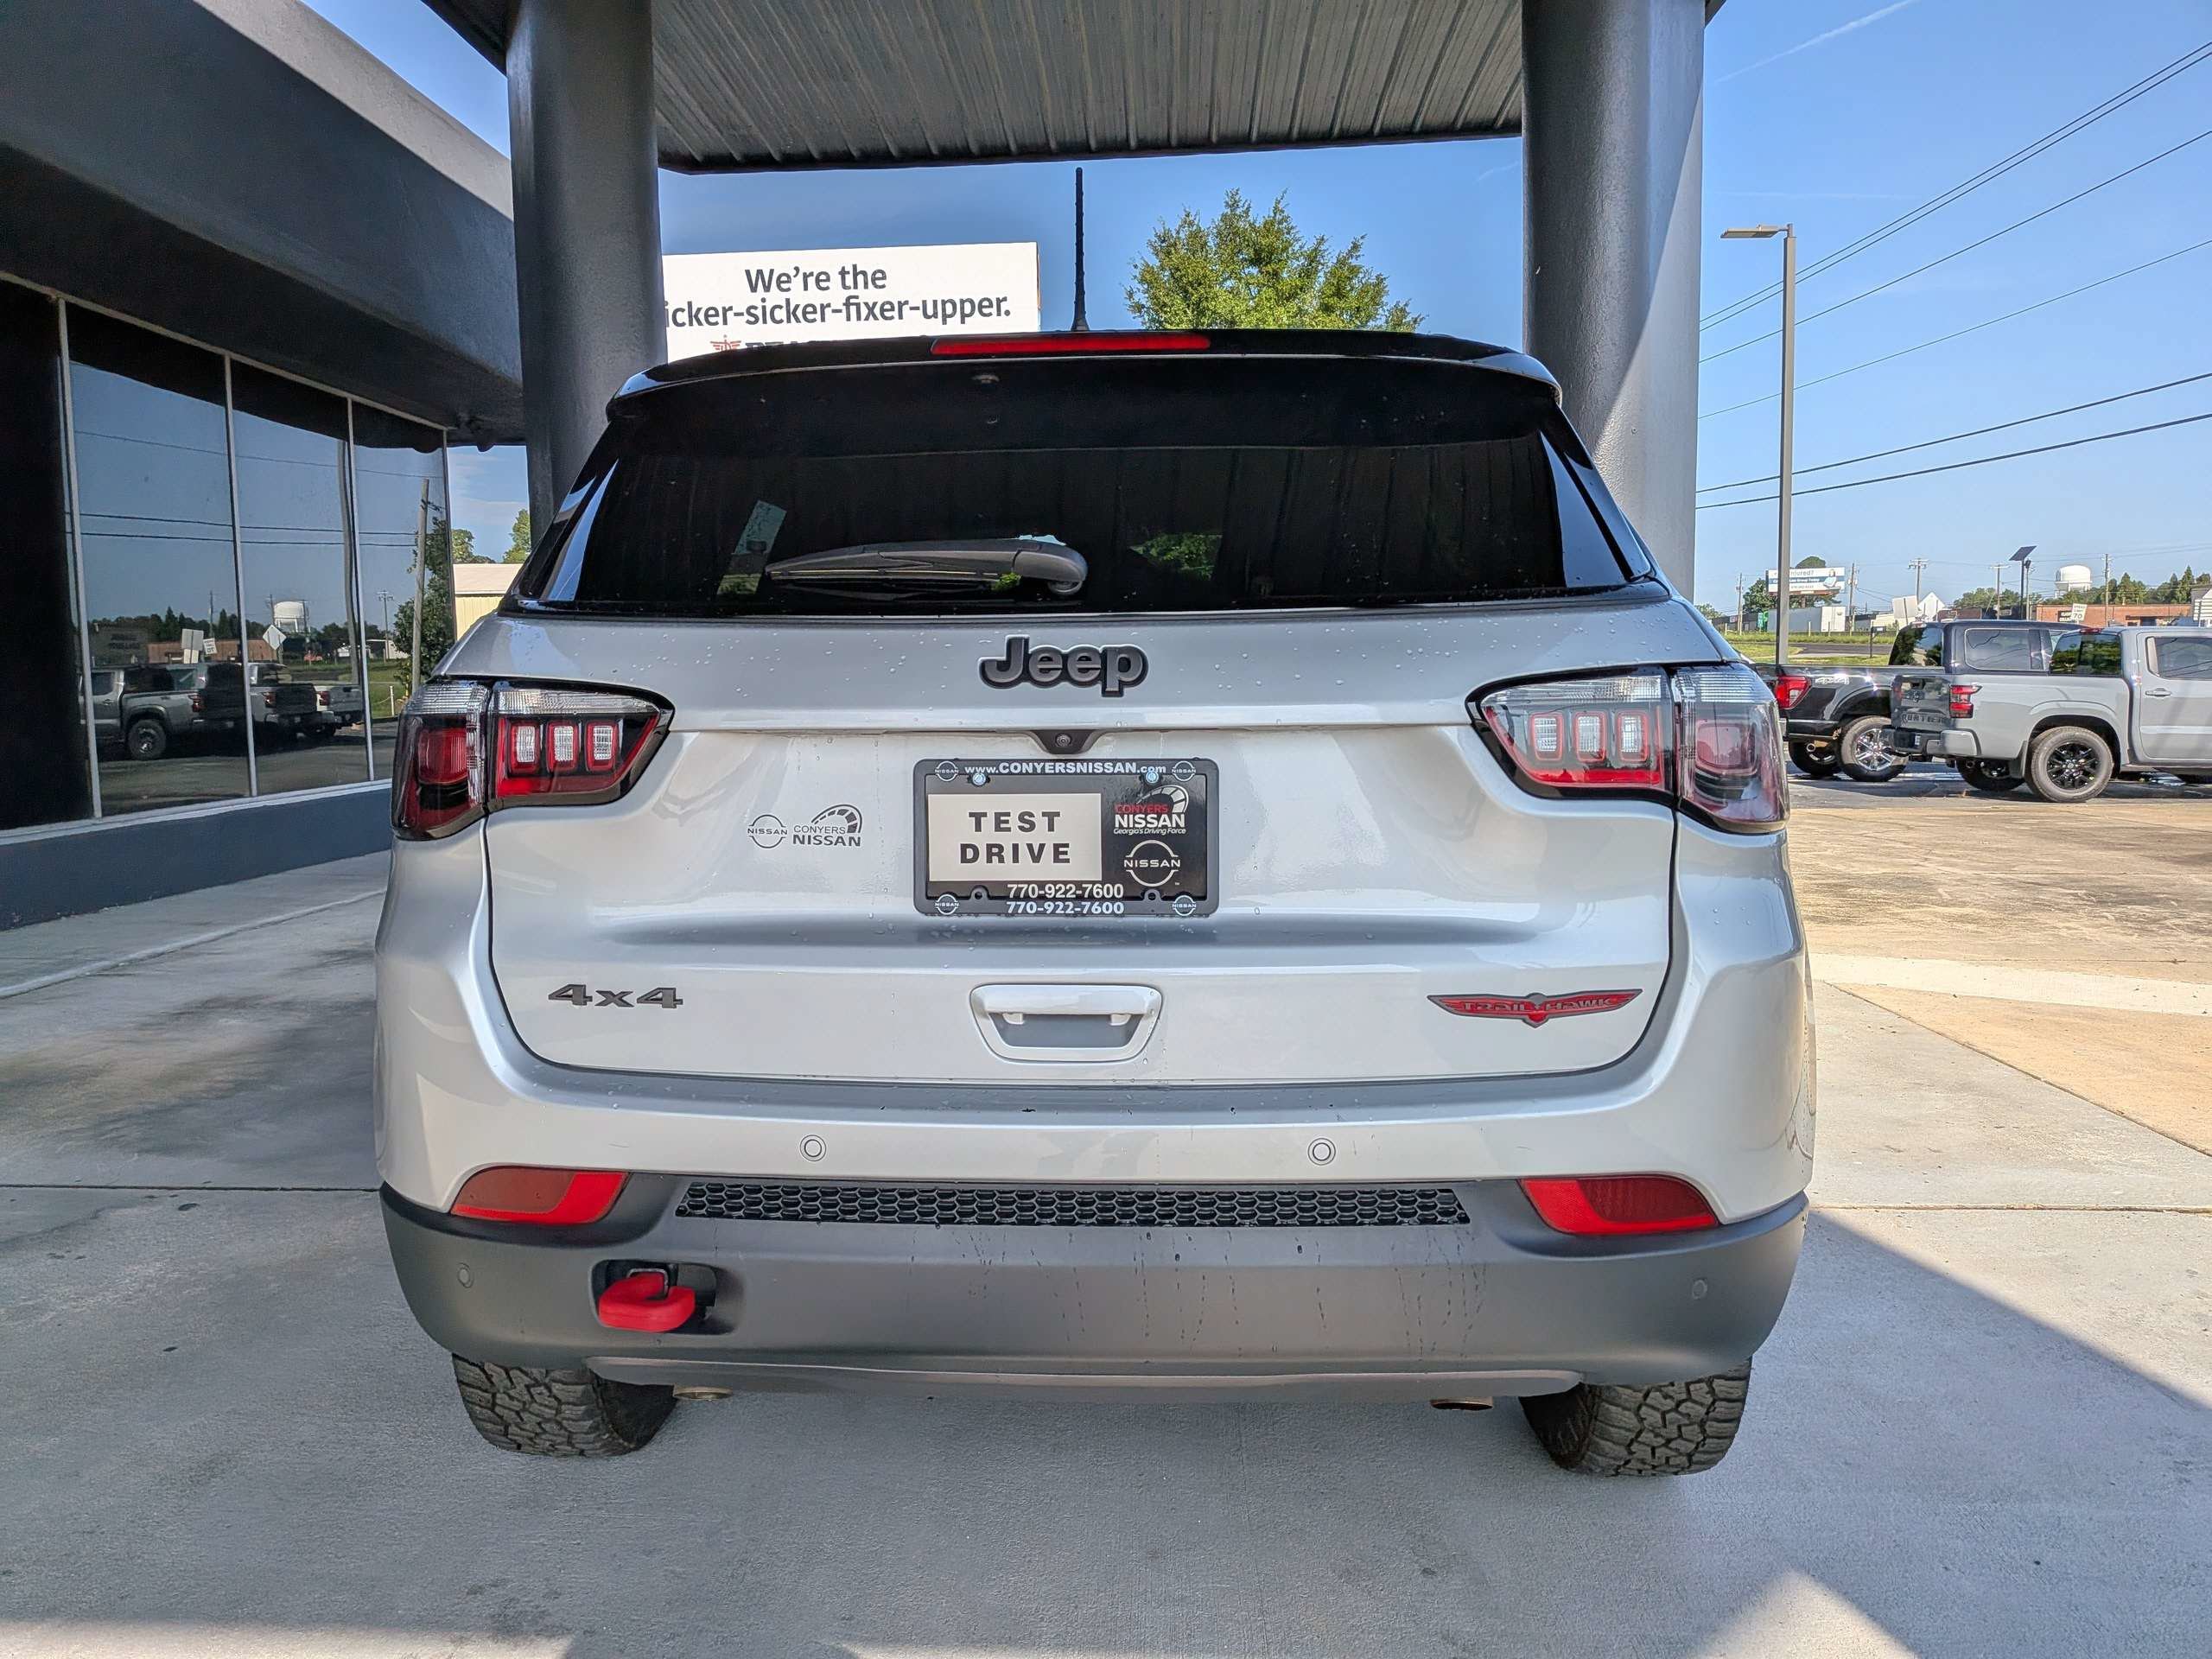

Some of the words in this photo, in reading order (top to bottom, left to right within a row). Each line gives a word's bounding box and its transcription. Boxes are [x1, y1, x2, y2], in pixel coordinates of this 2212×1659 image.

[745, 266, 831, 294] We’re
[838, 264, 888, 290] the
[664, 294, 1012, 327] icker-sicker-fixer-upper.
[978, 634, 1149, 698] Jeep
[964, 761, 1166, 774] www.CONYERSNISSAN.com
[1114, 804, 1169, 813] CONYERS
[968, 810, 1061, 833] TEST
[1115, 813, 1185, 828] NISSAN
[793, 824, 846, 835] CONYERS
[792, 834, 861, 847] NISSAN
[959, 842, 1071, 864] DRIVE
[1123, 859, 1181, 868] NISSAN
[1007, 883, 1124, 899] 770-922-7600
[1006, 901, 1124, 914] 770-922-7600
[548, 983, 683, 1009] 4x4
